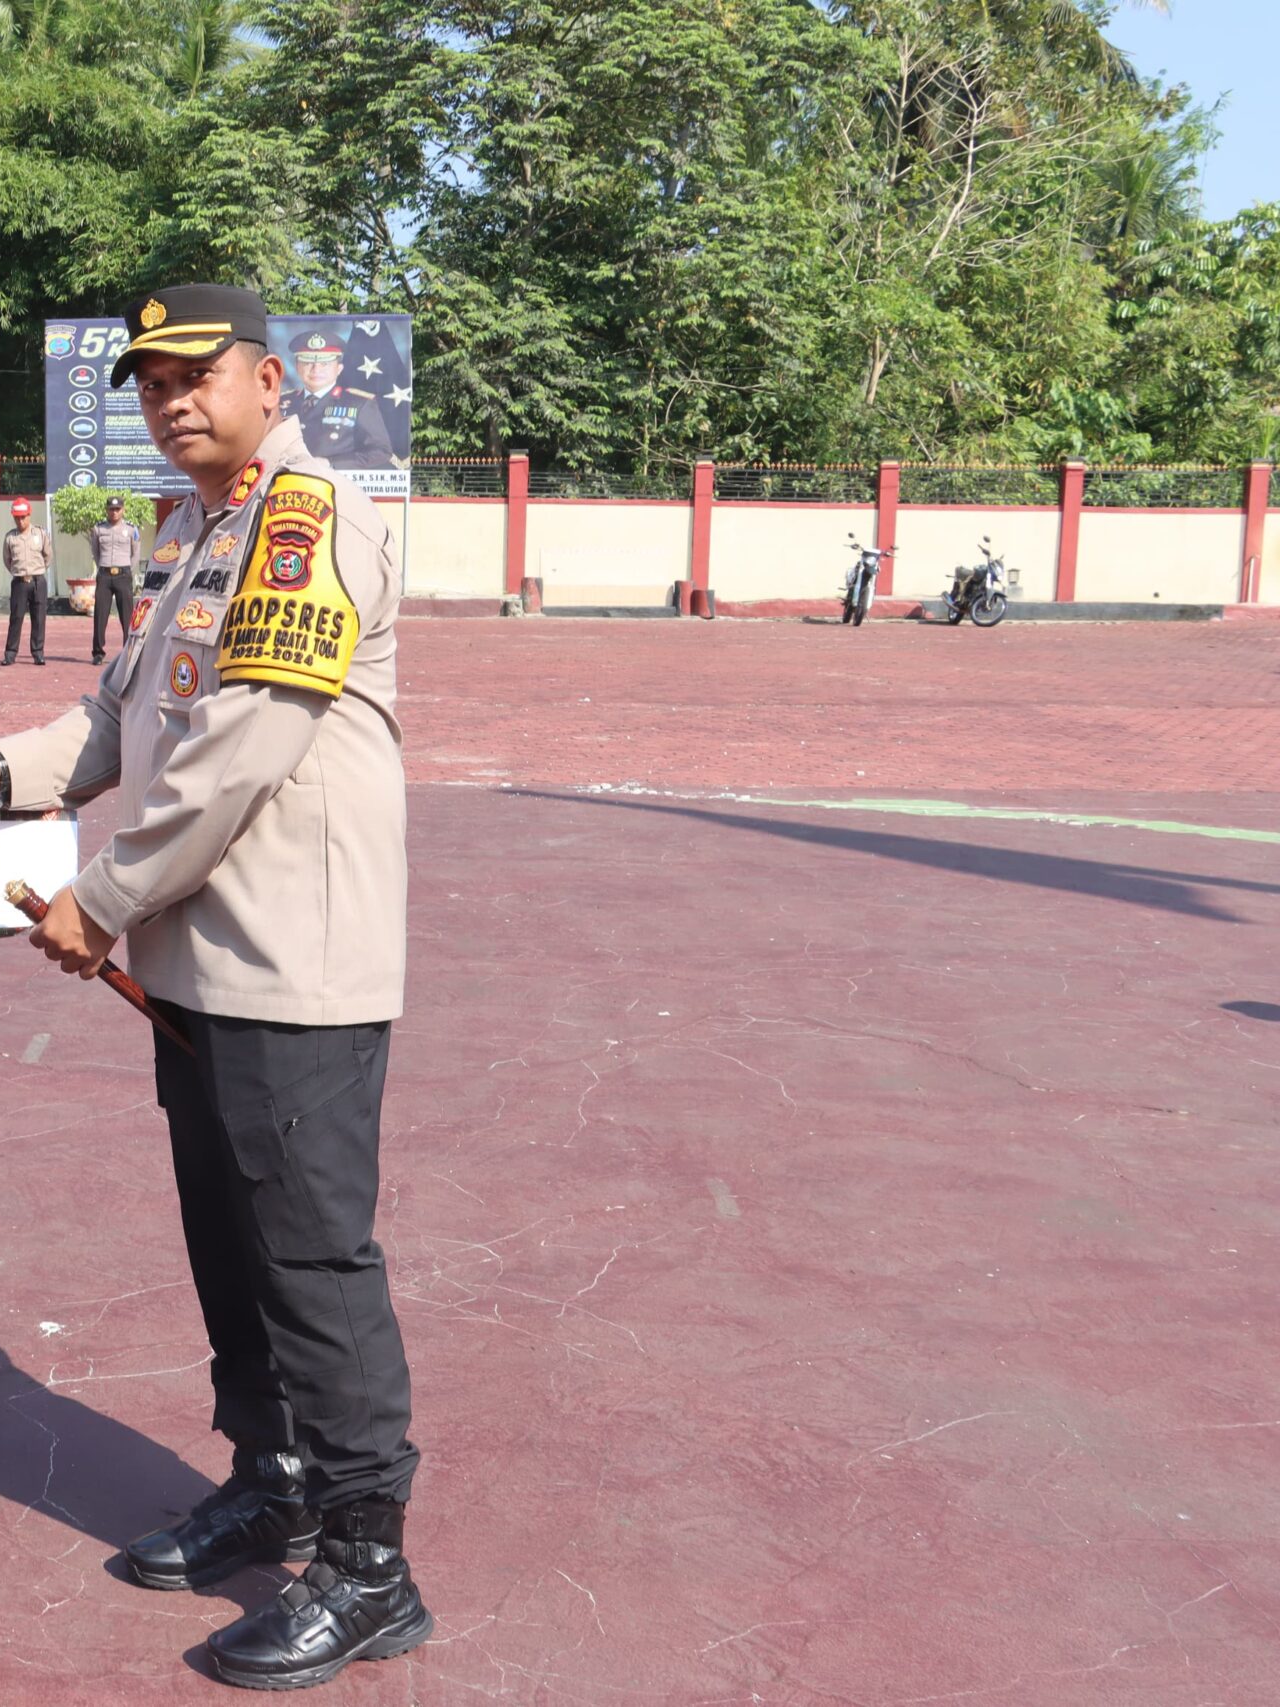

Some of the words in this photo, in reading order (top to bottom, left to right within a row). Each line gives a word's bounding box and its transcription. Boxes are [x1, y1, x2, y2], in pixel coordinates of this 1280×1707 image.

[79, 327, 108, 358] 5
[384, 485, 408, 493] UTARA
[275, 500, 322, 518] MADINA
[277, 492, 325, 511] POLRES
[226, 596, 345, 640] KAOPSRES
[274, 628, 308, 651] BRATA
[313, 636, 339, 661] TOBA
[230, 646, 314, 667] 2023-2024
